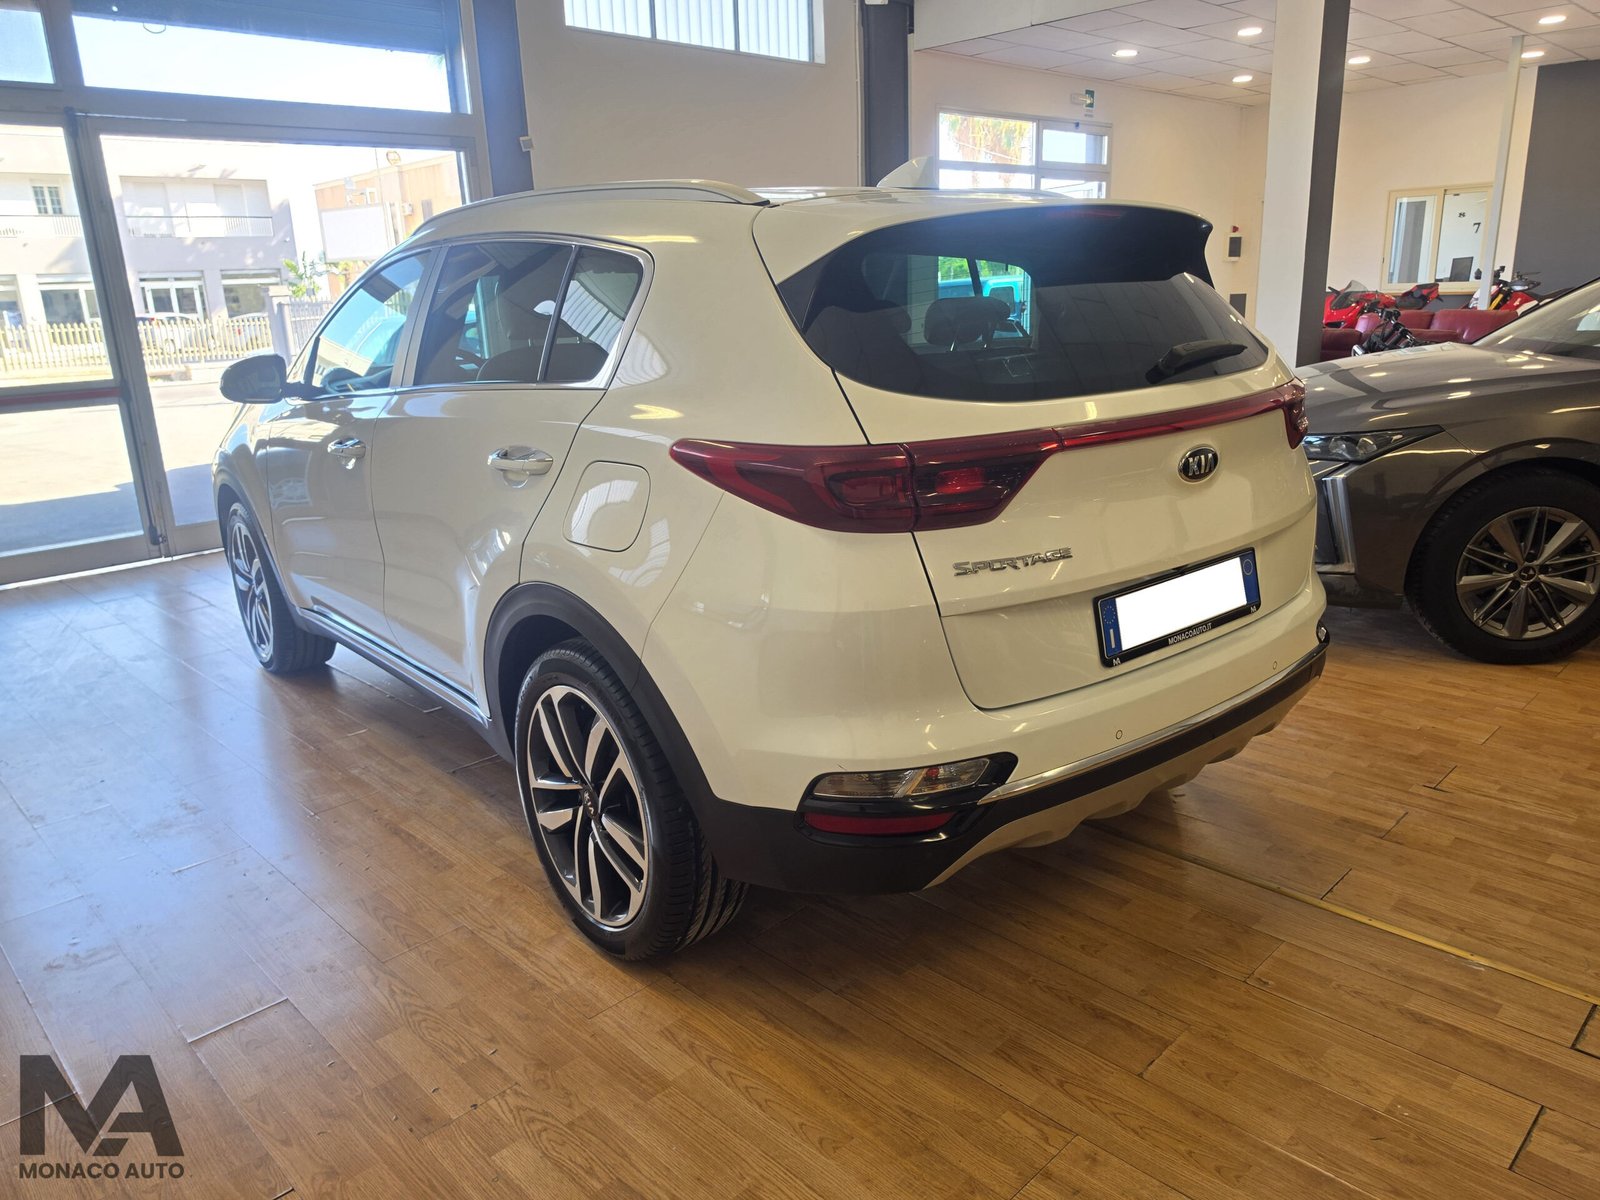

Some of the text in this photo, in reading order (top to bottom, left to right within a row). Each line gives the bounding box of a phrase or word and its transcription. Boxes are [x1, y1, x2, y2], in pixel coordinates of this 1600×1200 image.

[1188, 453, 1214, 476] KIA
[952, 547, 1073, 576] SPORTAGE
[1168, 623, 1212, 645] MONACOAUTO.IT
